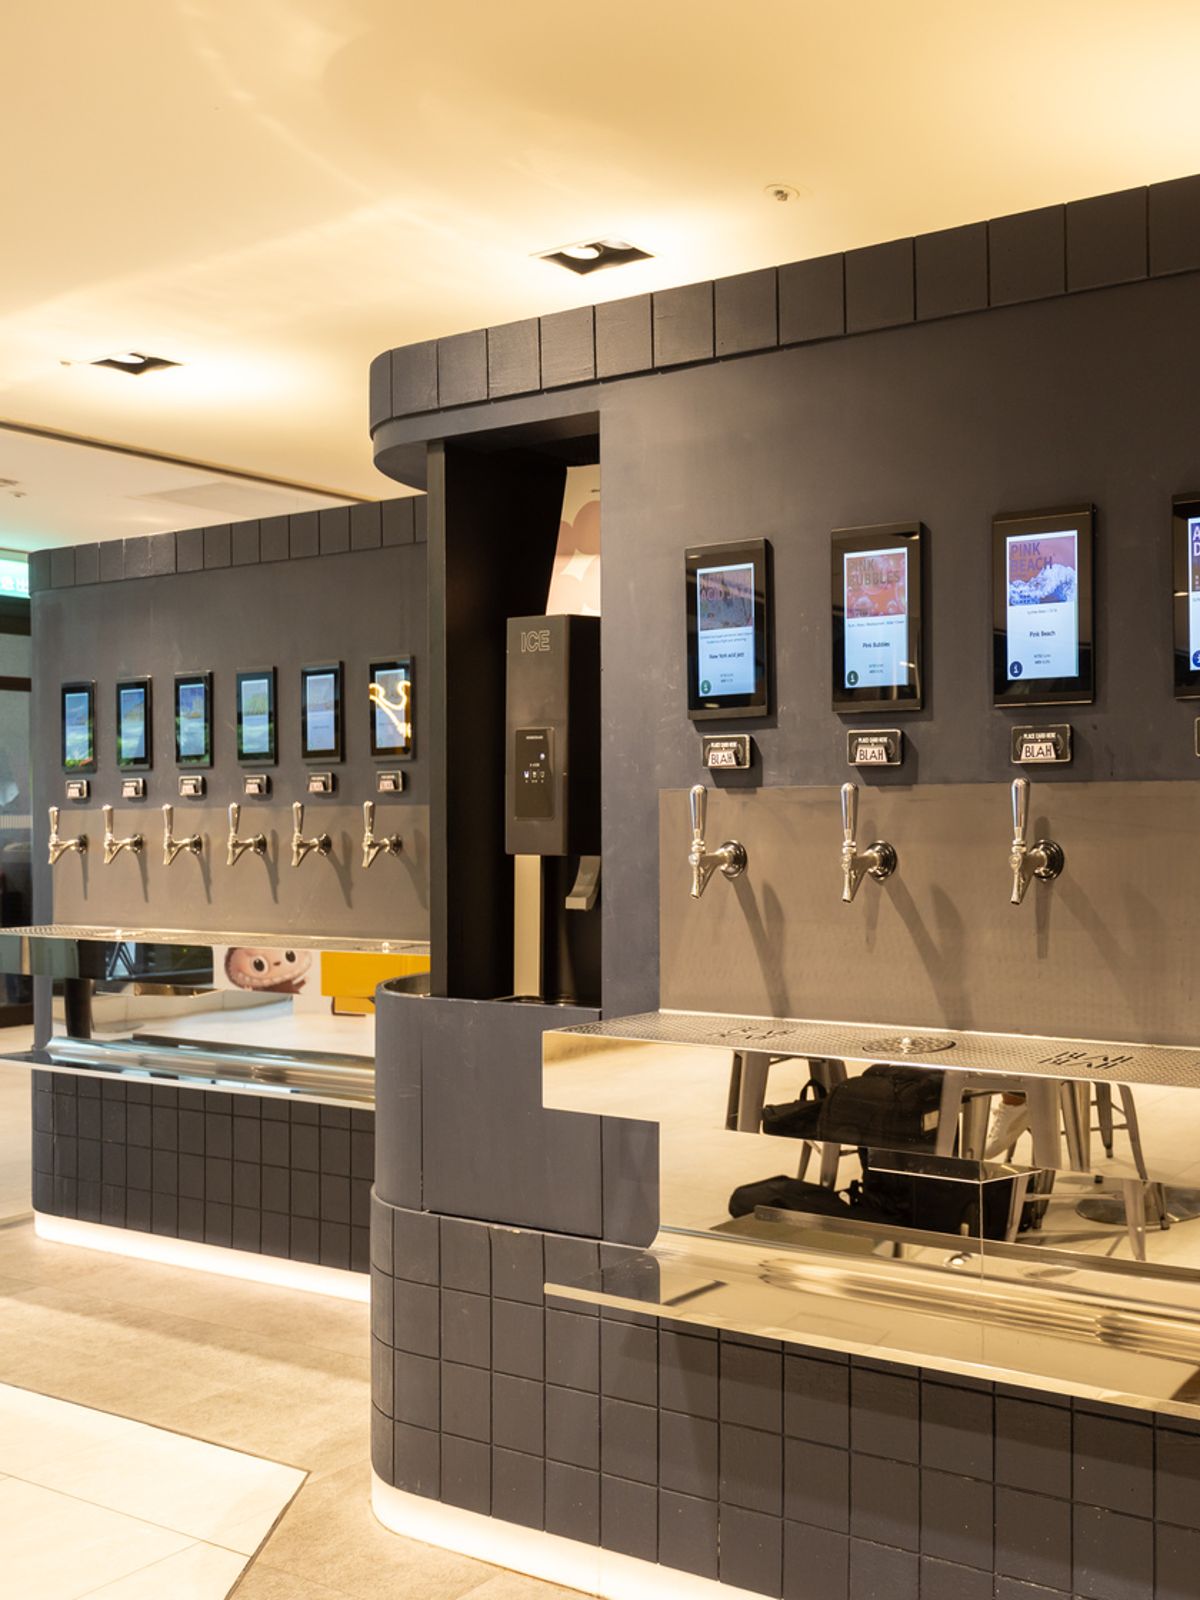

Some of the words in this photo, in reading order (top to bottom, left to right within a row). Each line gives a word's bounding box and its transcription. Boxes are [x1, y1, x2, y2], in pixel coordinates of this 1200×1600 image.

[1011, 542, 1040, 558] PINK
[1011, 555, 1052, 573] BEACH
[520, 629, 550, 653] ICE
[859, 749, 883, 760] BLAH
[1026, 745, 1052, 757] BLAH
